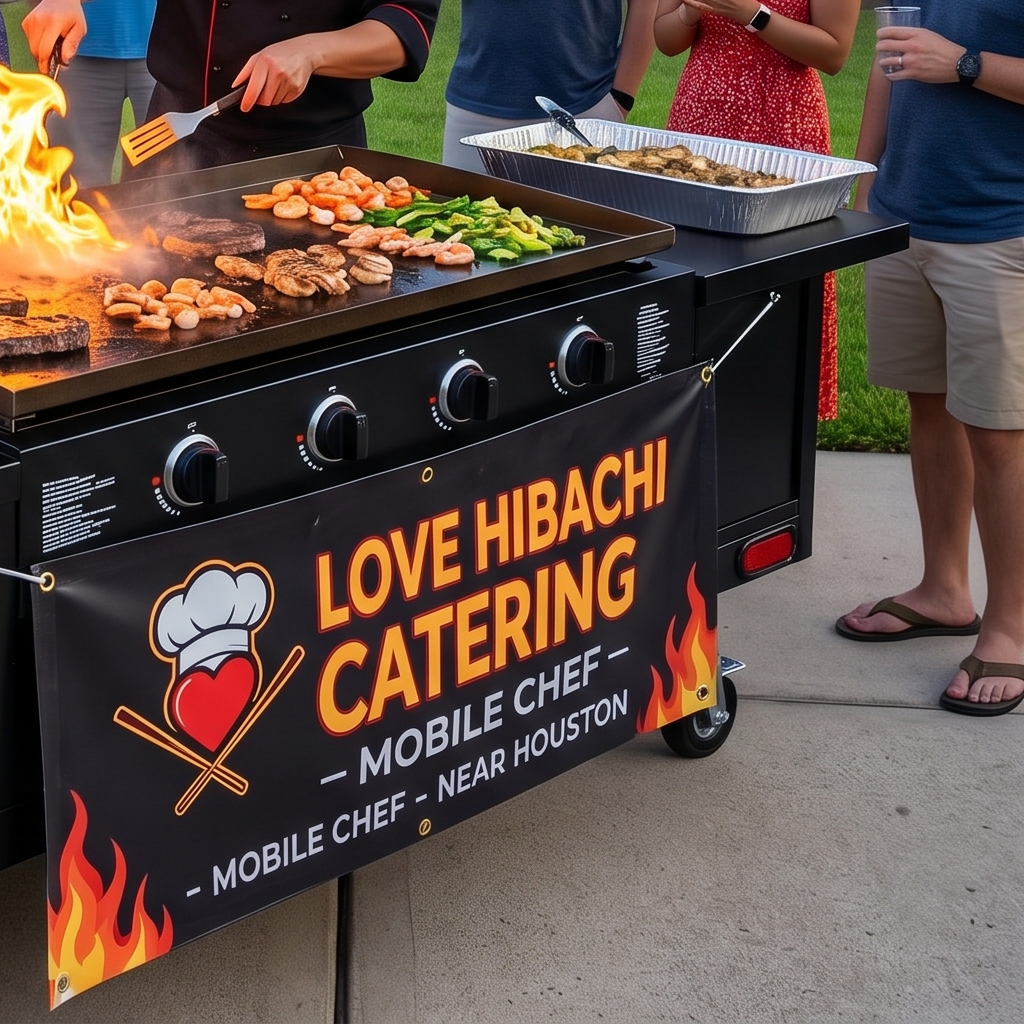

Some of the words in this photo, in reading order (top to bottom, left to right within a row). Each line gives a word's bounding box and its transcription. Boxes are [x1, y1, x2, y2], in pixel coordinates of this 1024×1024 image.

[317, 510, 463, 632] LOVE
[475, 438, 668, 573] HIBACHI
[317, 534, 638, 735] CATERING
[359, 688, 504, 785] MOBILE
[513, 644, 602, 716] CHEF
[212, 822, 324, 896] MOBILE
[332, 790, 406, 844] CHEF
[438, 748, 506, 803] NEAR
[513, 688, 628, 768] HOUSTON
